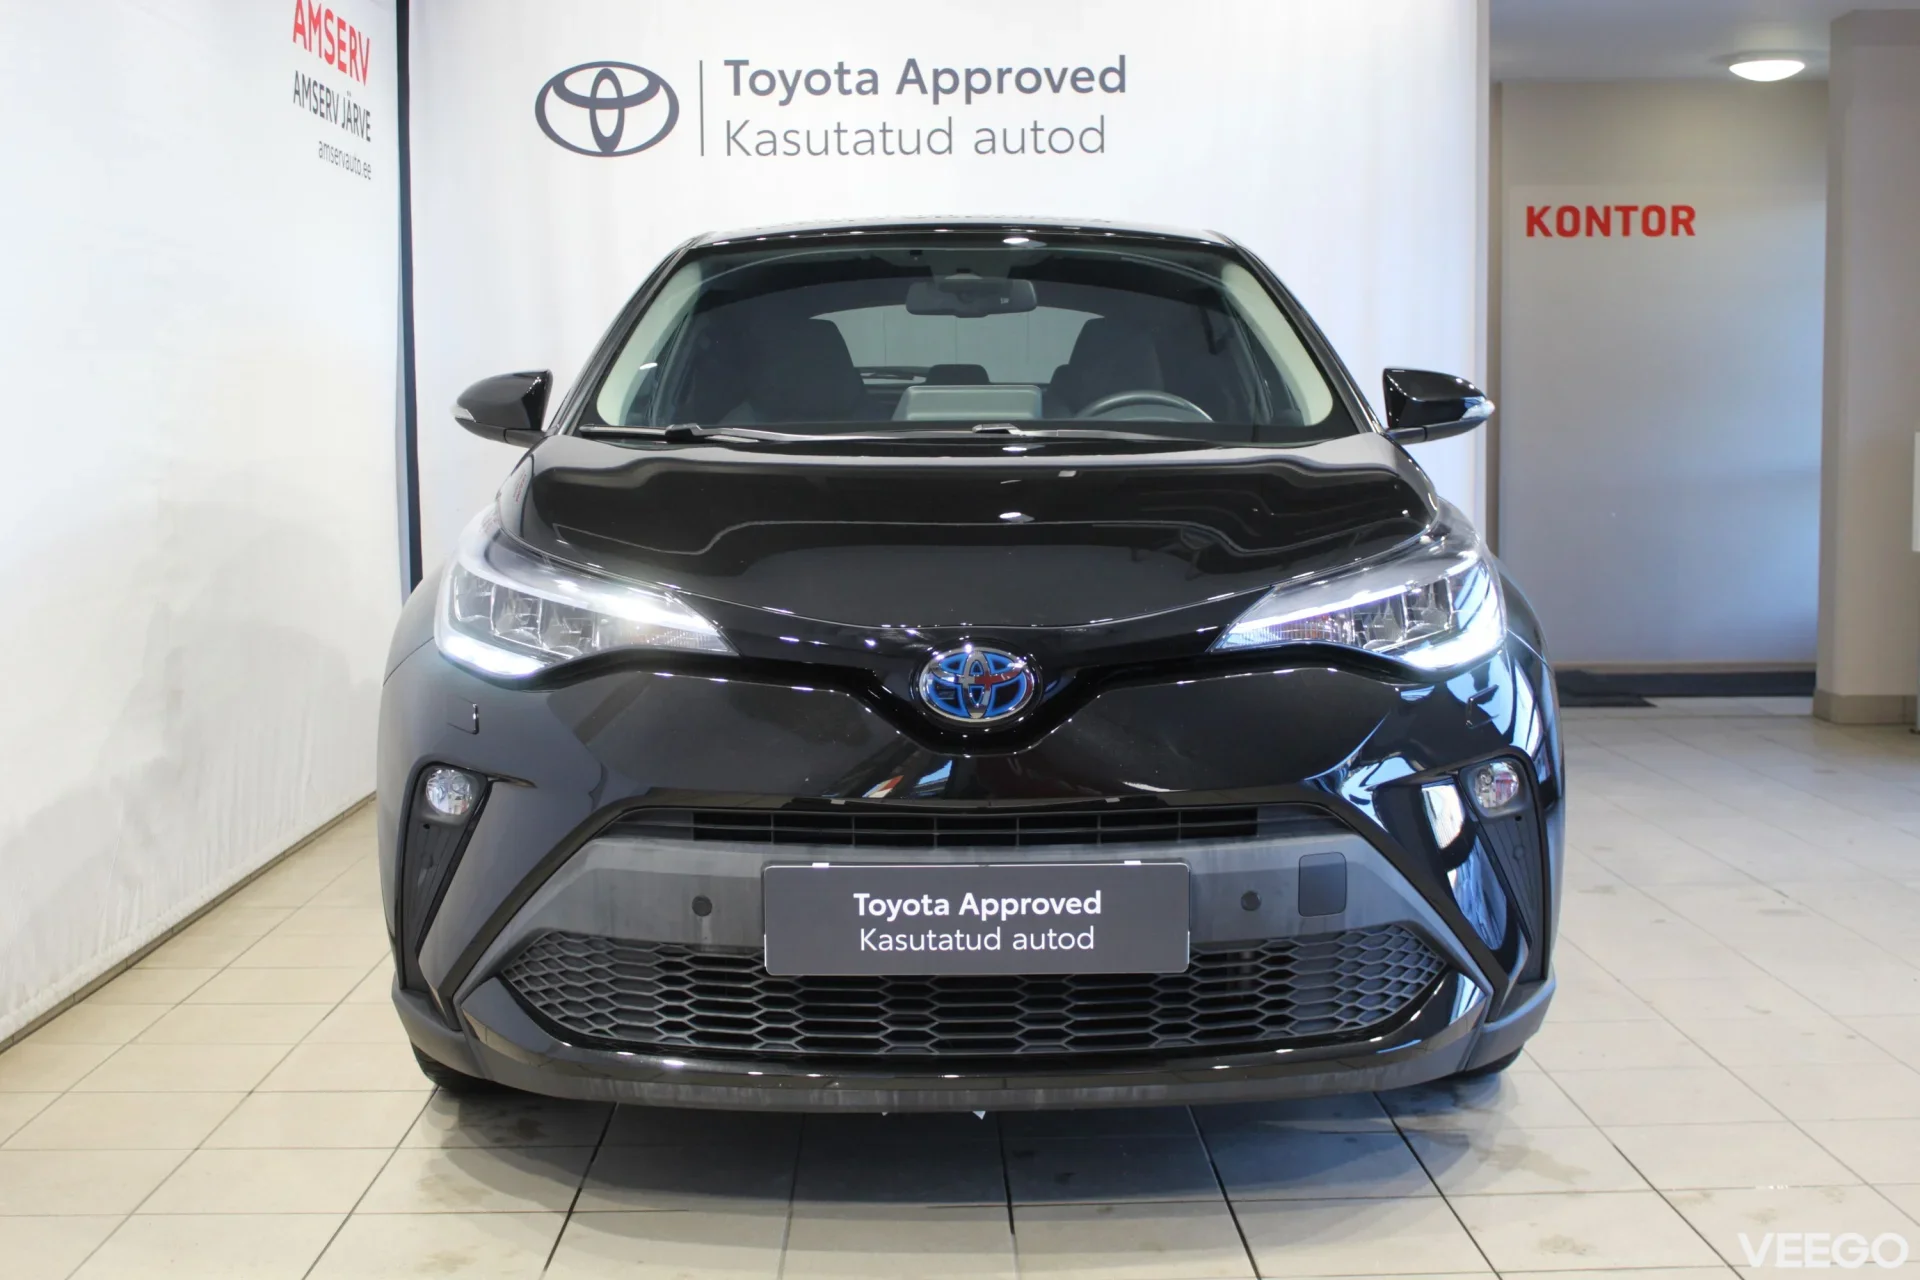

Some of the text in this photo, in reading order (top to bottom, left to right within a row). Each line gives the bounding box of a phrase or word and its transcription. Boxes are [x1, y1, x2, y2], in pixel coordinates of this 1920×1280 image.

[293, 0, 369, 86] AMSERV
[723, 55, 1126, 106] Toyota Approved
[293, 70, 371, 143] AMSERV JÄRVE
[726, 115, 1105, 157] Kasutatud autod
[318, 140, 372, 181] amservauto.ee
[1525, 204, 1697, 238] KONTOR
[853, 890, 1102, 922] Toyota Approved
[860, 925, 1095, 952] Kasutatud autod
